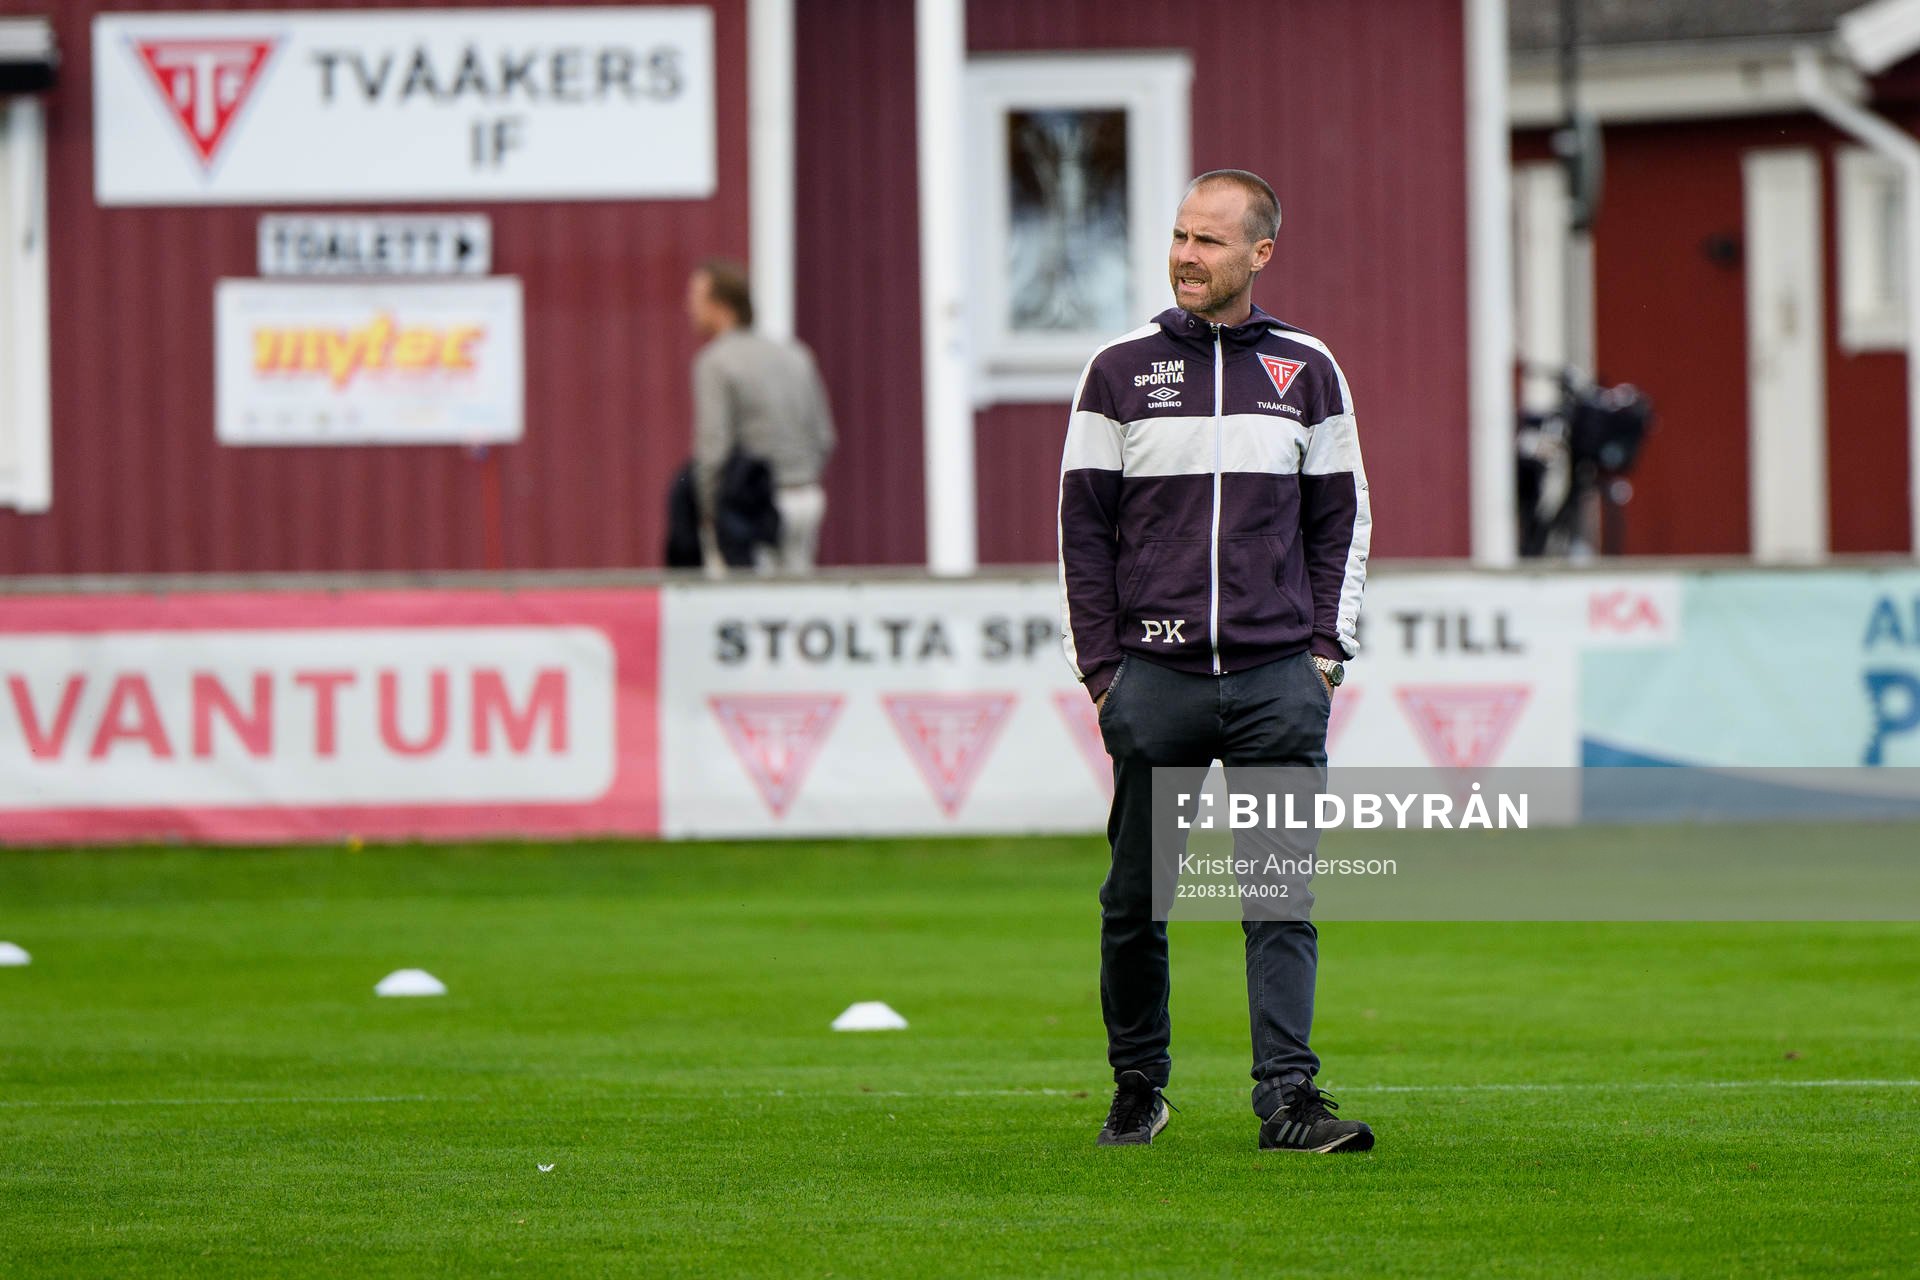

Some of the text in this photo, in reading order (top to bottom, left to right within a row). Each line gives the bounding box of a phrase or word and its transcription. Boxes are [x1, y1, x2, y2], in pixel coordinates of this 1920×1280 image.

[312, 44, 684, 102] TVÅÅKERS
[470, 114, 529, 168] IF
[272, 227, 444, 265] TOALETT
[254, 308, 486, 391] mytec
[1151, 359, 1185, 373] TEAM
[1133, 371, 1185, 387] SPORTIA
[1147, 400, 1182, 409] UMBRO
[1141, 619, 1186, 643] PK
[1588, 590, 1662, 633] ICA
[715, 617, 954, 664] STOLTA
[1391, 609, 1525, 655] TILL
[5, 668, 571, 761] VANTUM
